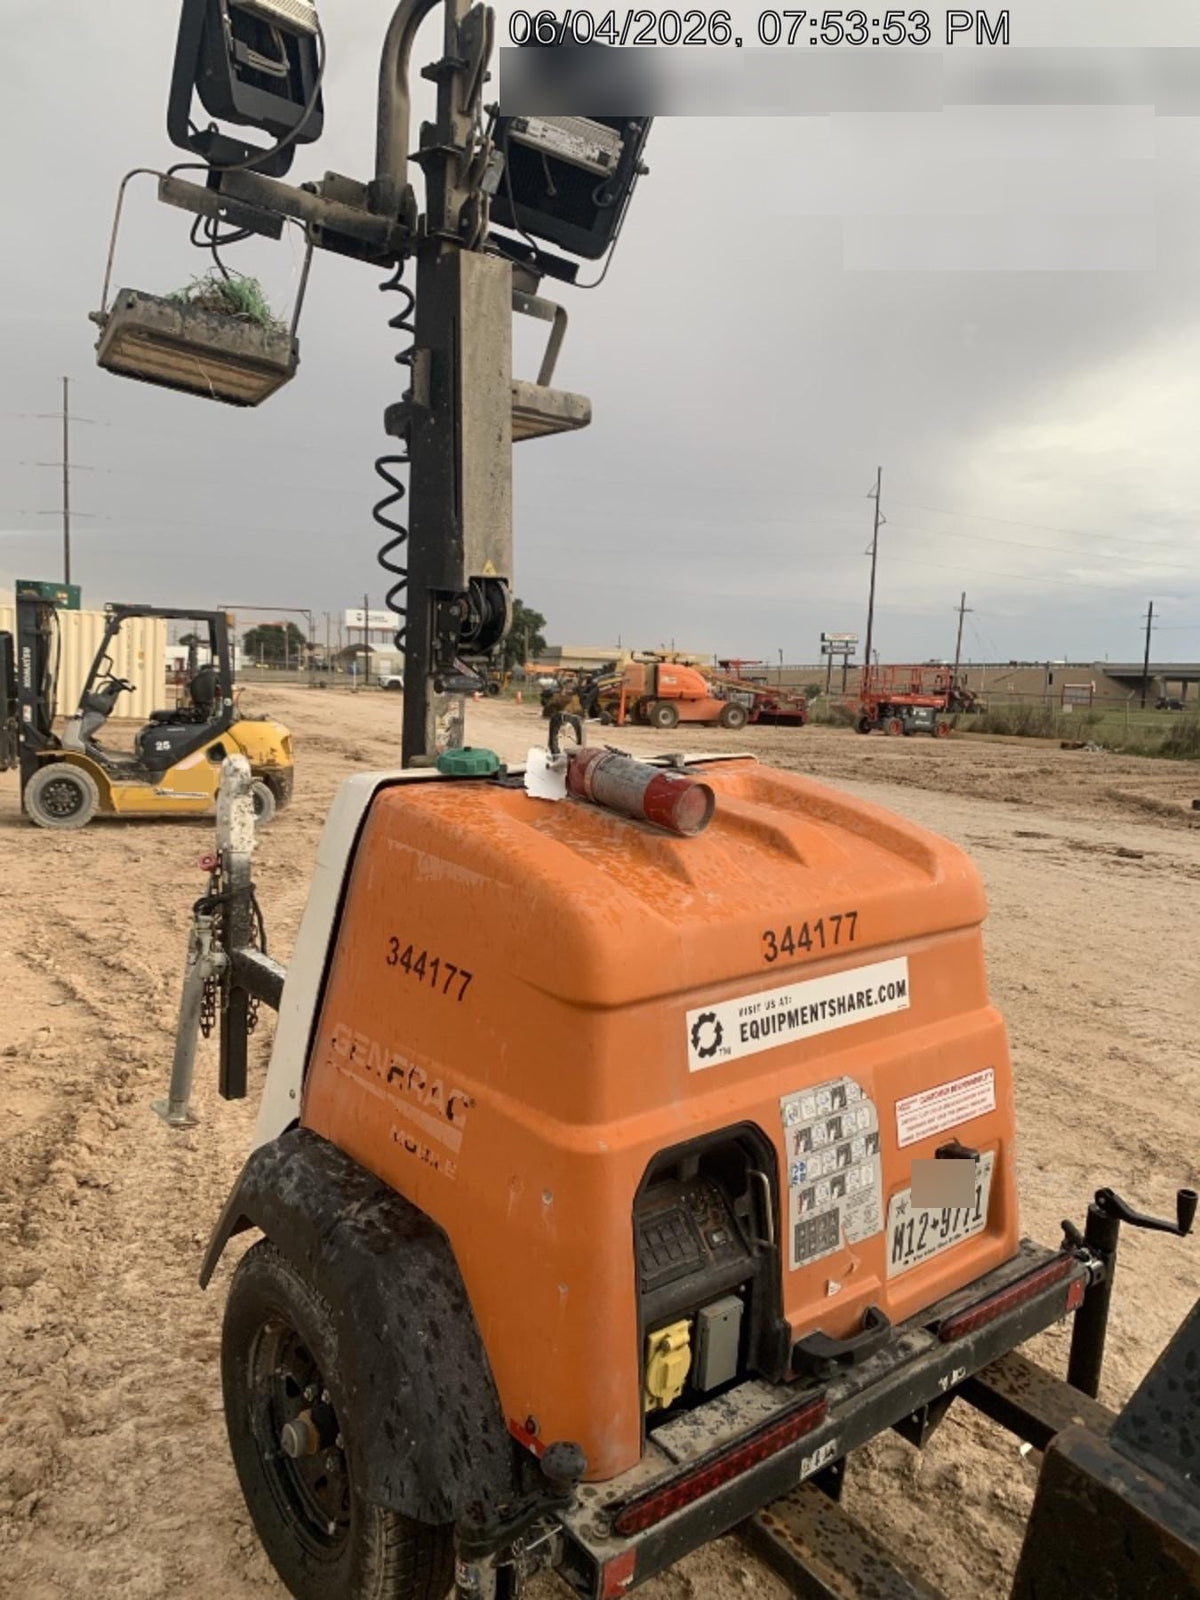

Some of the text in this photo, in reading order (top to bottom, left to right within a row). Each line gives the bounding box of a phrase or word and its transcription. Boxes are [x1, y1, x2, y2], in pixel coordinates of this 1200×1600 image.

[155, 741, 171, 751] 25
[761, 910, 858, 962] 344177
[386, 936, 473, 1002] 344177
[739, 995, 792, 1018] VISIT US AT:
[739, 979, 907, 1042] EQUIPMENTSHARE.COM
